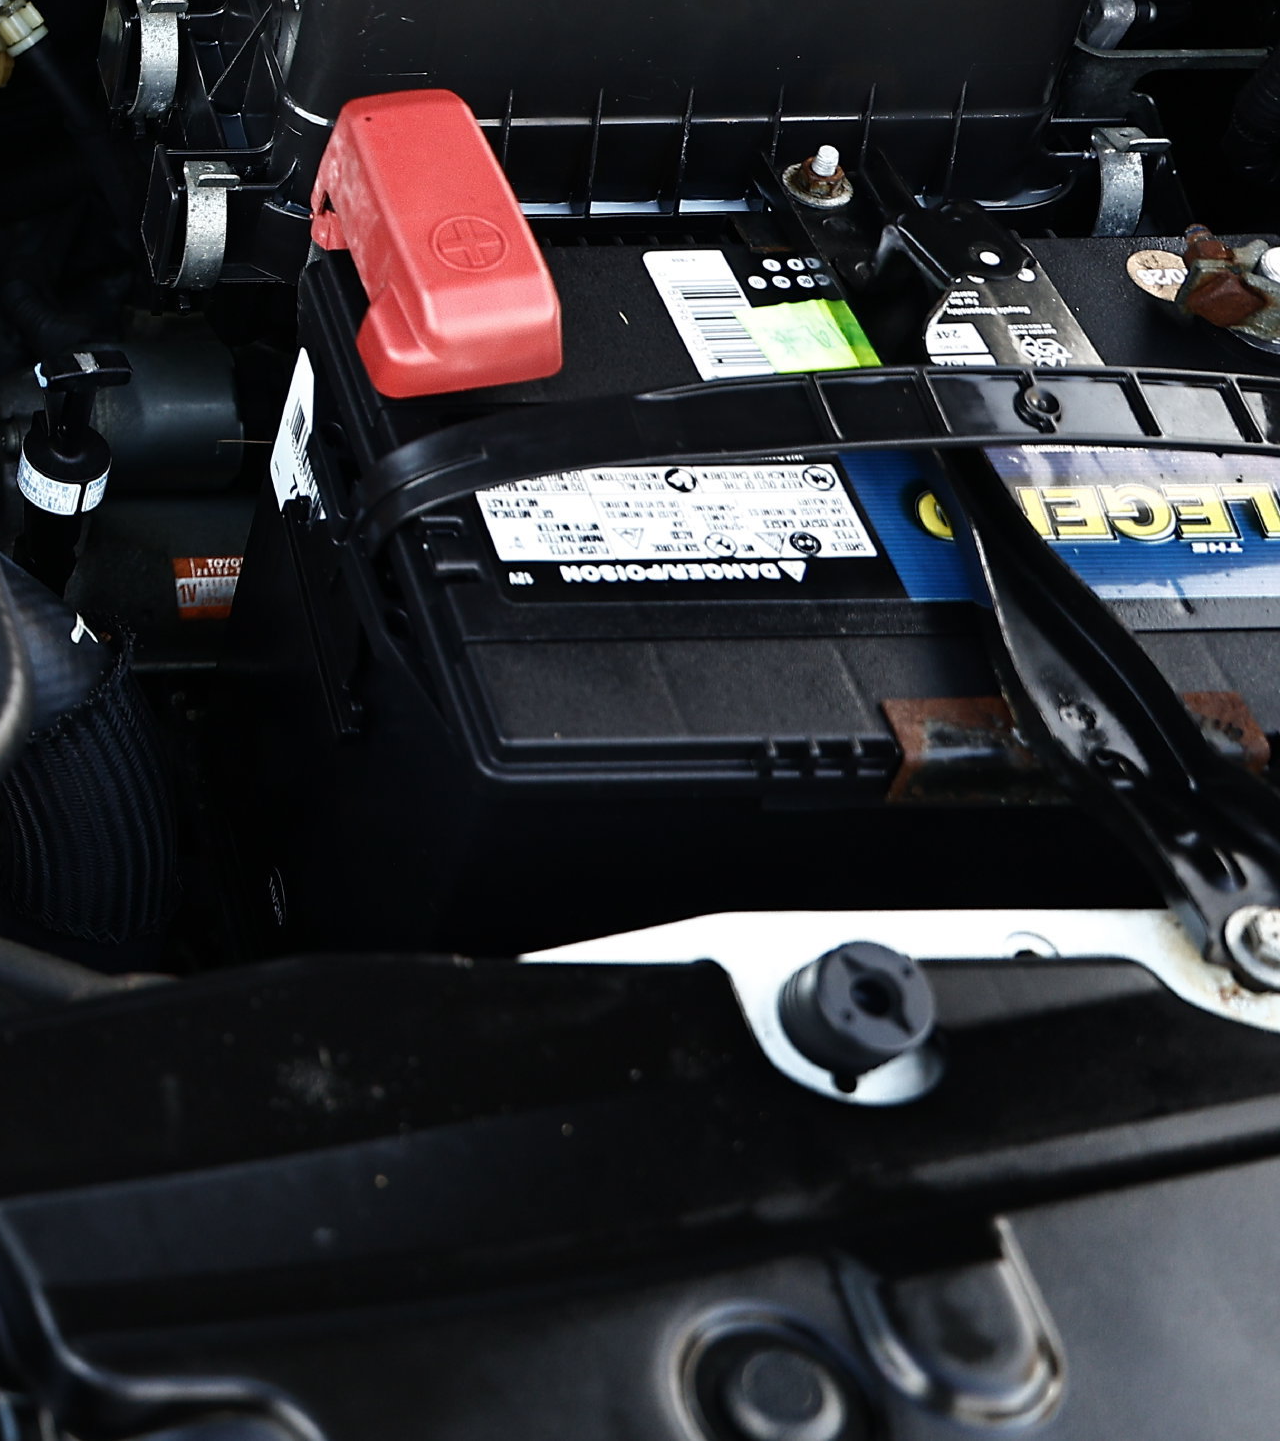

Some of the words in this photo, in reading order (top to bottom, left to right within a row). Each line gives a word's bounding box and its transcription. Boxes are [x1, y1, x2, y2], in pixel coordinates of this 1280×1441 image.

[590, 471, 661, 482] INSTRUCTIONS
[701, 471, 749, 481] CHILDREN
[766, 470, 799, 480] REACH
[723, 481, 740, 490] THE
[757, 481, 776, 490] OUT
[779, 480, 804, 489] KEEP
[486, 498, 510, 508] FAST
[515, 498, 539, 508] HELP
[487, 509, 532, 519] MEDICAL
[536, 509, 554, 519] GET
[535, 522, 571, 531] WATER
[574, 522, 600, 531] WITH
[762, 519, 794, 529] GASES
[799, 518, 854, 529] EXPLOSIVE
[536, 533, 605, 543] IMMEDIATELY
[669, 530, 693, 540] ACID
[832, 529, 860, 540] EYES
[549, 545, 575, 555] EYES
[579, 545, 610, 555] FLUSH
[650, 543, 701, 553] SULFURIC
[830, 541, 867, 552] SHIELD
[1192, 542, 1243, 553] THE
[559, 563, 781, 582] DANGER/POISON
[178, 583, 197, 604] 1V
